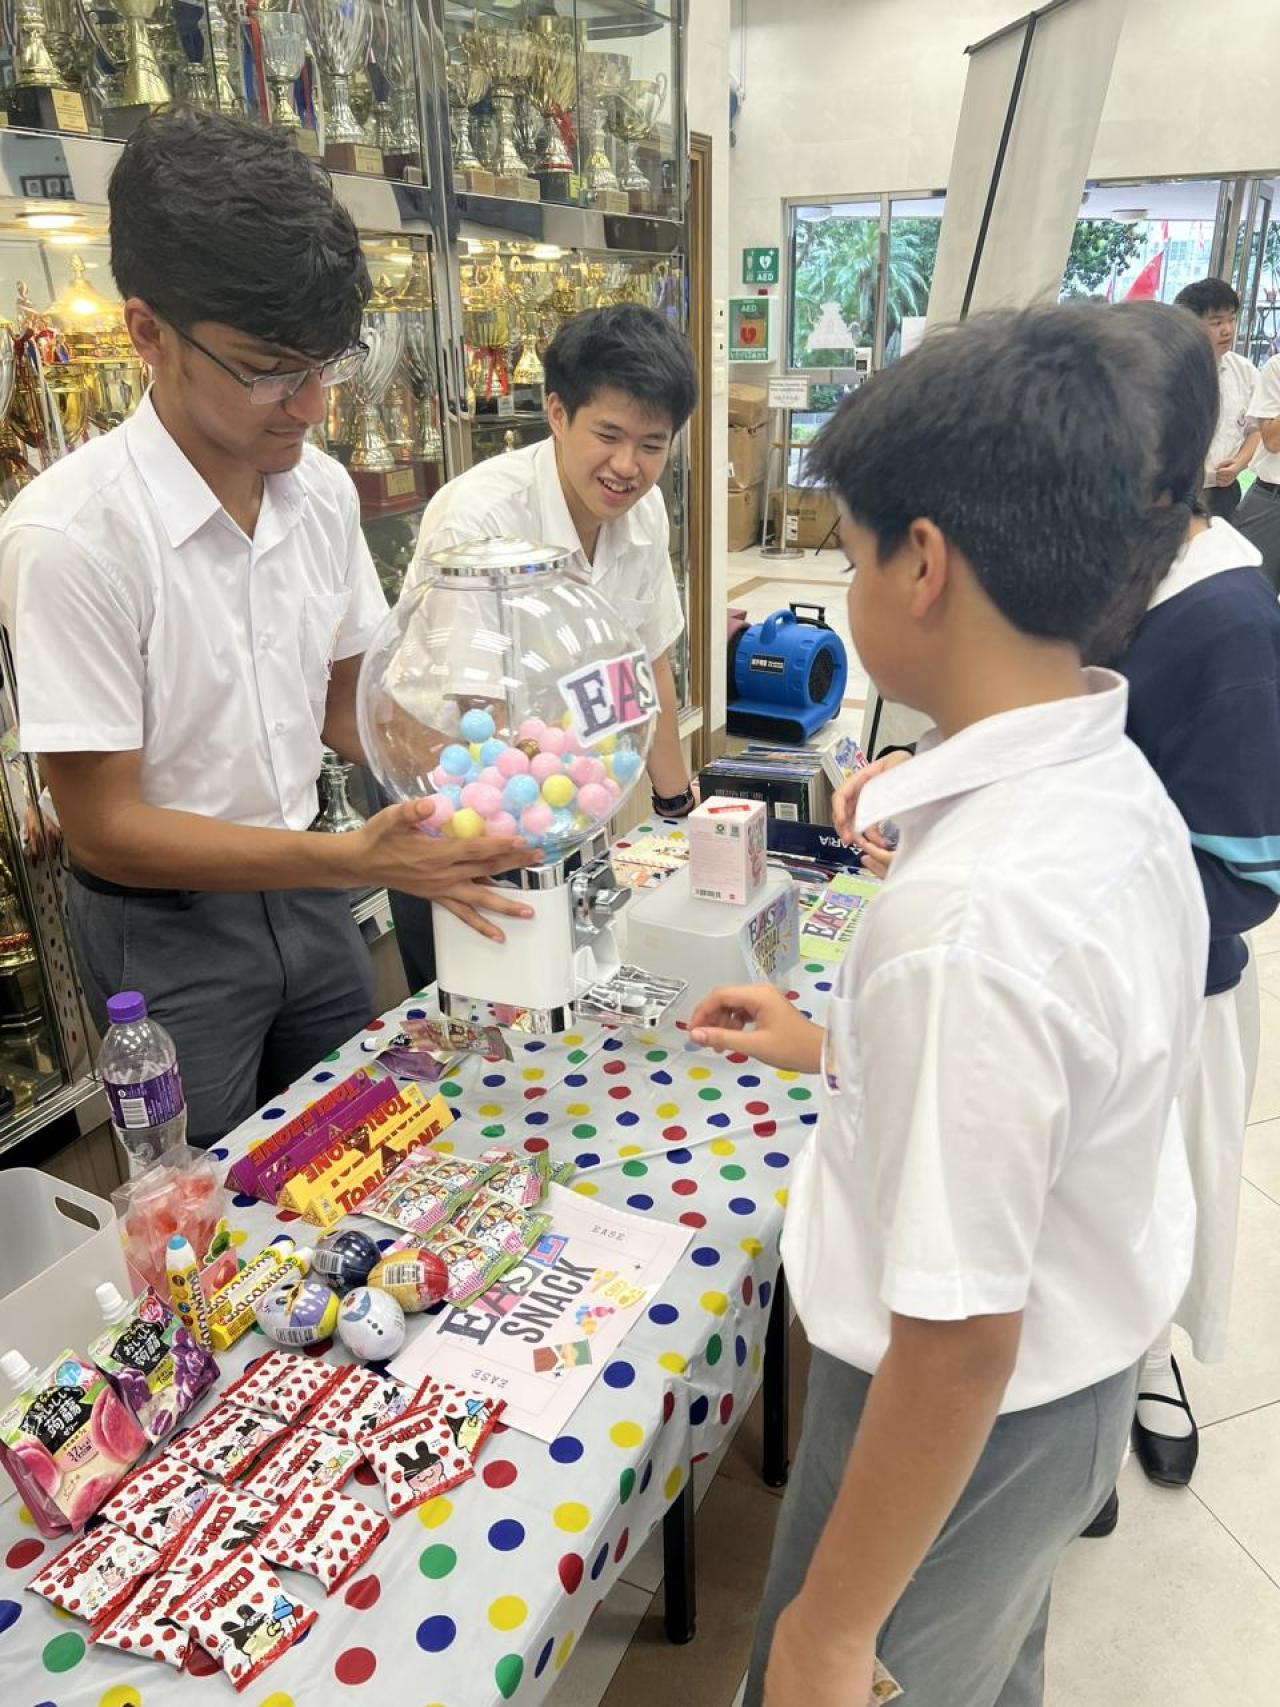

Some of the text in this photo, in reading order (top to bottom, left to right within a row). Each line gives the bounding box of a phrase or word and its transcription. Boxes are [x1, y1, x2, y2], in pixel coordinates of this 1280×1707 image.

[756, 272, 774, 282] AED
[740, 304, 757, 313] AED
[499, 1257, 598, 1344] SNACK
[33, 1390, 67, 1425] おいしい
